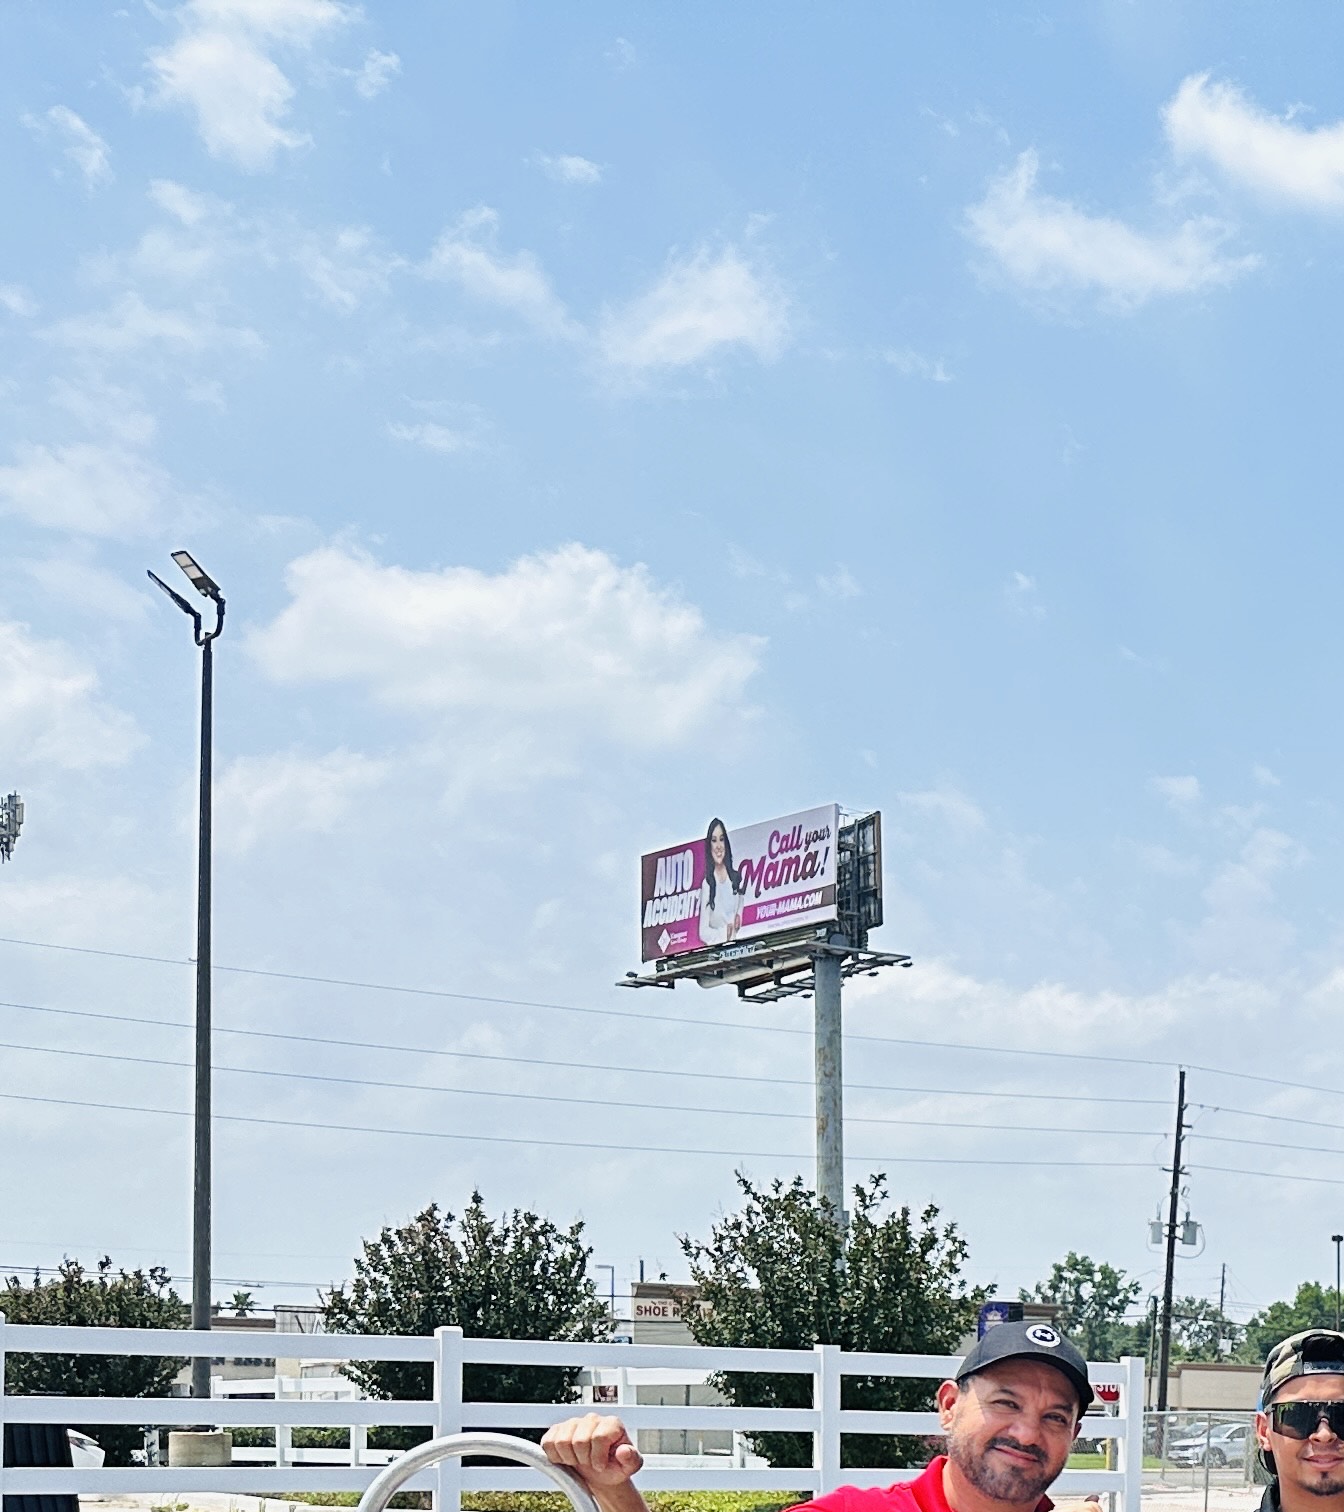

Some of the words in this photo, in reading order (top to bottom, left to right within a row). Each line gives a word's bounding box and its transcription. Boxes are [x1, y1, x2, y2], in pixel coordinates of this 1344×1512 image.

[768, 824, 803, 859] Call
[804, 825, 831, 852] your
[654, 849, 693, 898] AUTO
[738, 847, 830, 898] Mama!
[636, 1305, 669, 1317] SHOE
